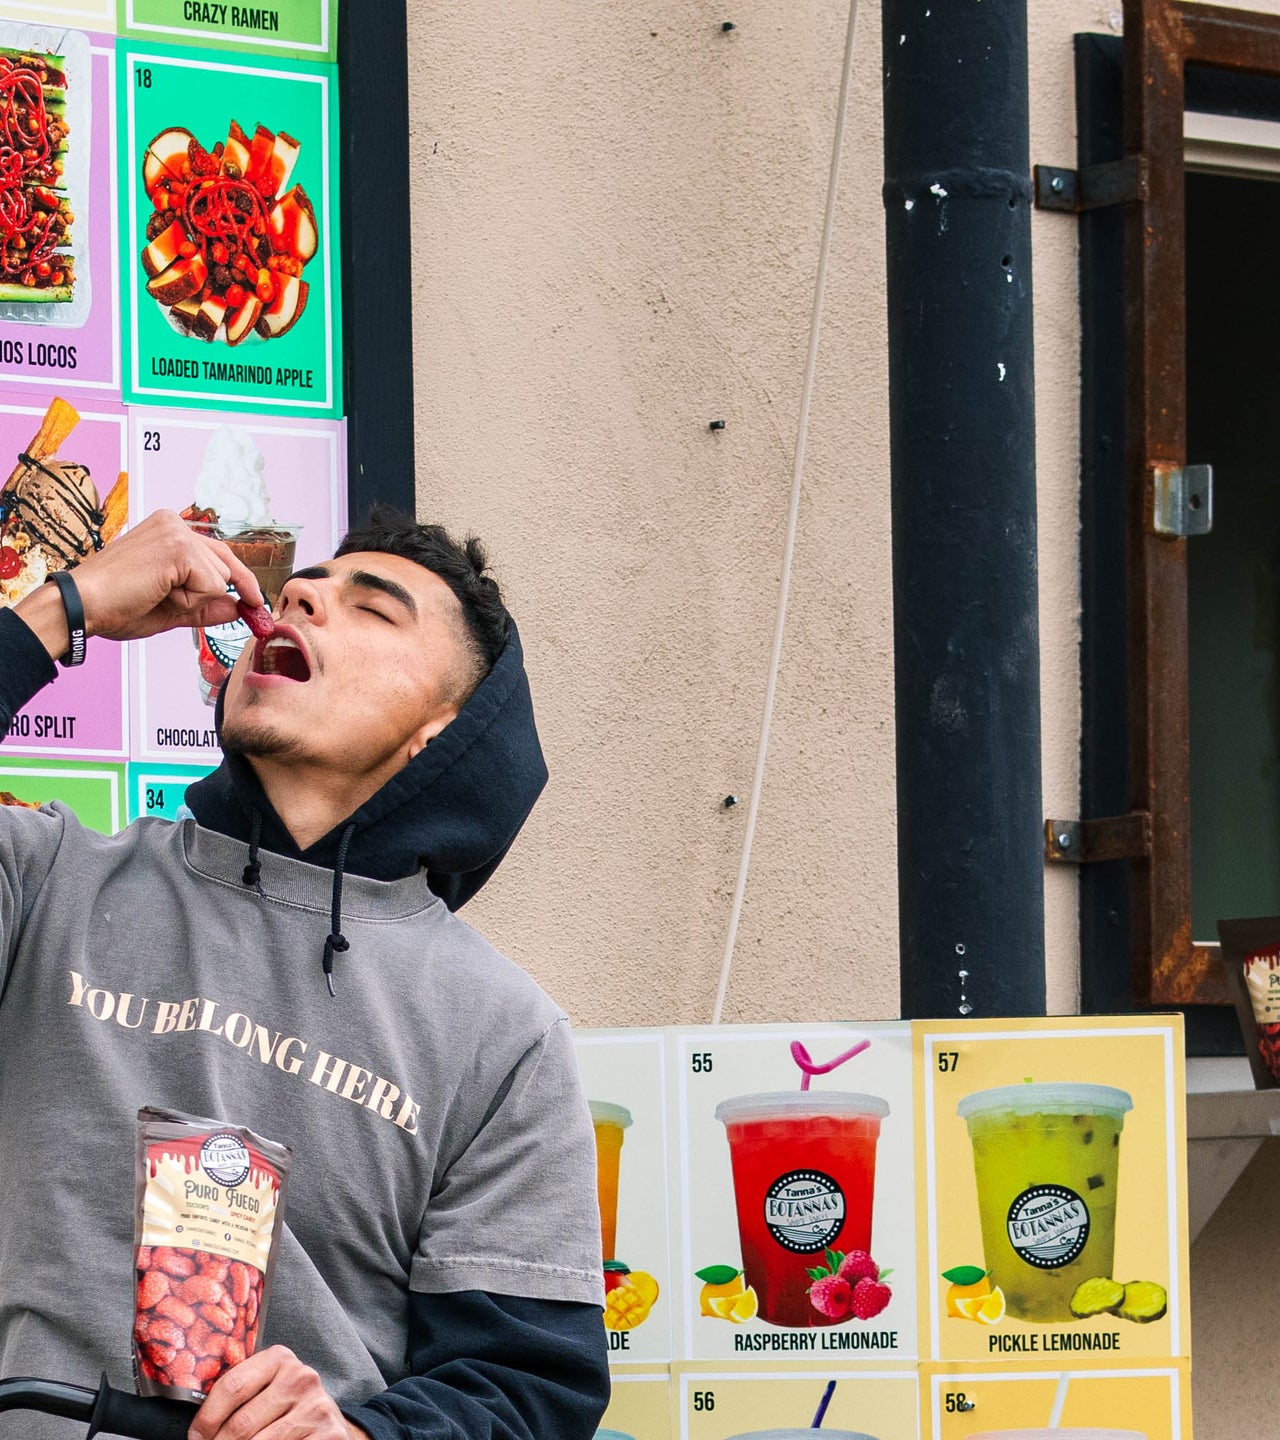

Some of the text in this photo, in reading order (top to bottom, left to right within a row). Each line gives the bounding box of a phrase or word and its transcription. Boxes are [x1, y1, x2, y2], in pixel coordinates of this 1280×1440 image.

[183, 1, 279, 32] CRAZY RAMEN
[135, 69, 152, 88] 18
[27, 341, 77, 370] LOCOS
[152, 356, 313, 389] LOADED TAMARINDO APPLE
[144, 431, 161, 451] 23
[34, 715, 76, 739] SPLIT
[157, 728, 220, 748] CHOCOLAT
[146, 789, 165, 809] 34
[67, 971, 422, 1136] YOU BELONG HERE
[692, 1053, 713, 1073] 55
[938, 1053, 959, 1072] 57
[784, 1185, 822, 1197] Tanna's
[769, 1193, 838, 1217] BOTANNAS
[1023, 1198, 1060, 1217] Tanna's
[1012, 1202, 1080, 1239] BOTANNAS
[734, 1331, 898, 1352] RASPBERRY LEMONADE
[989, 1331, 1121, 1352] PICKLE LEMONADE
[693, 1391, 715, 1413] 56
[945, 1392, 967, 1414] 58
